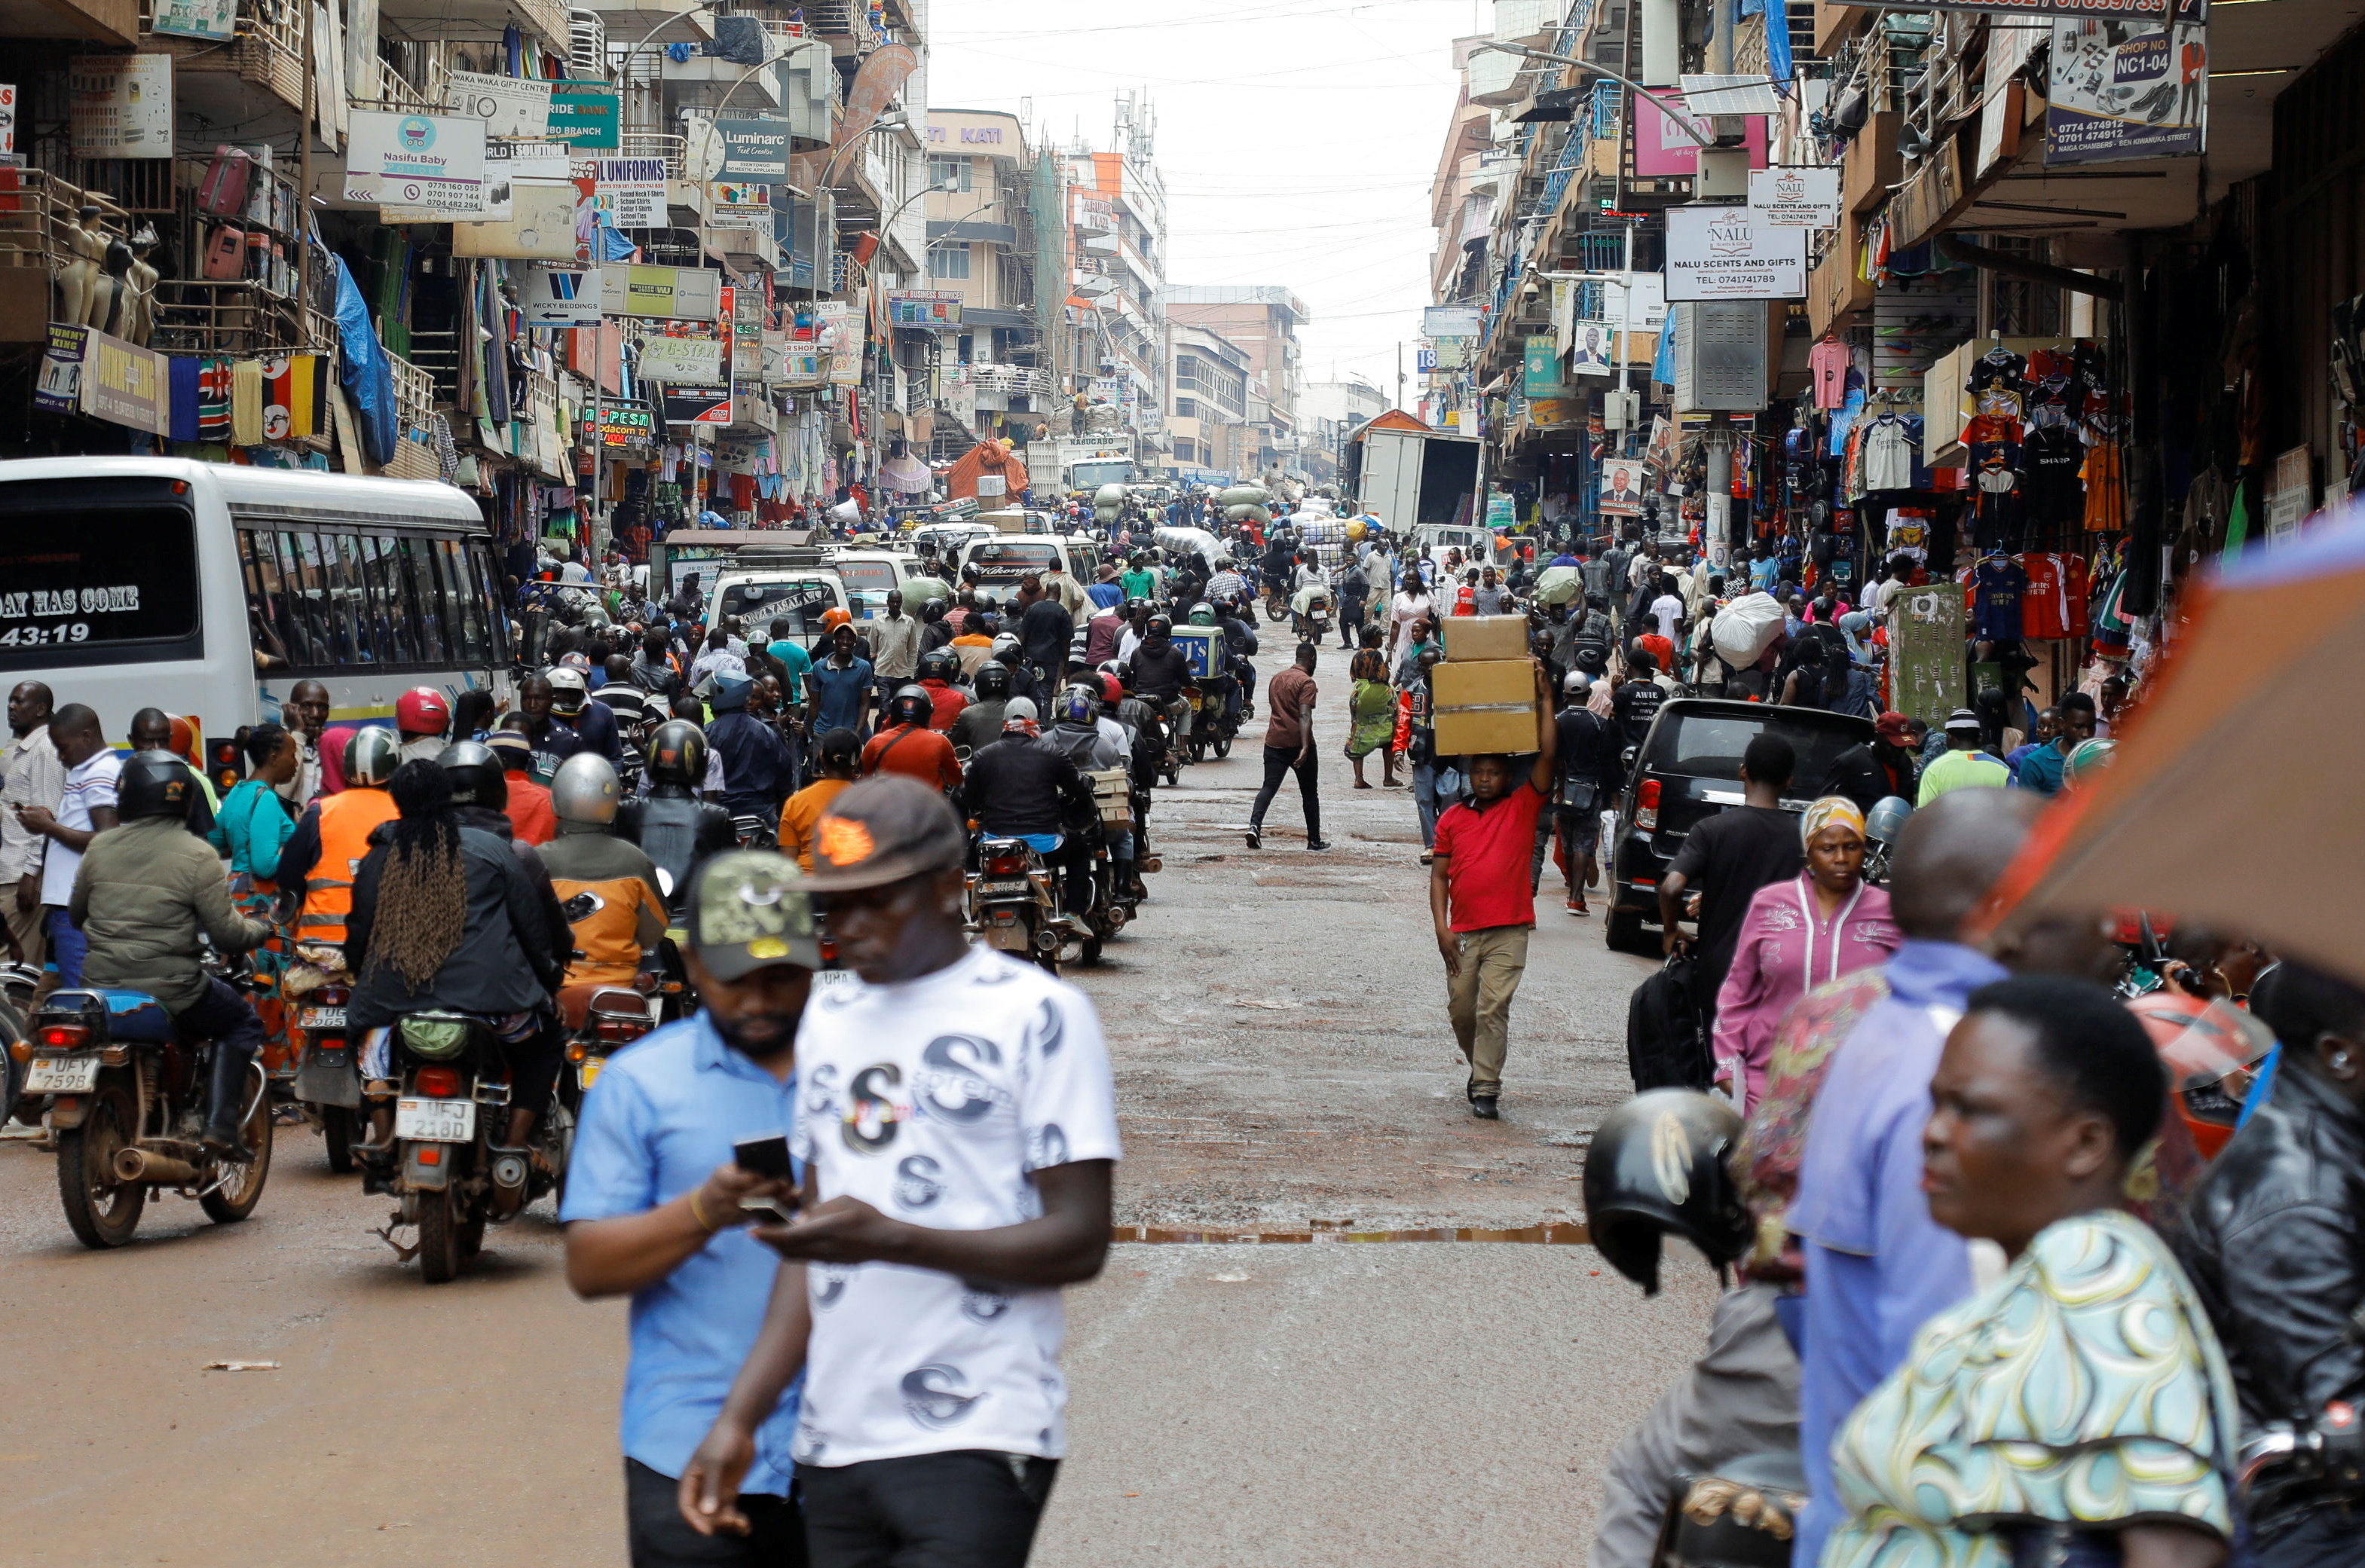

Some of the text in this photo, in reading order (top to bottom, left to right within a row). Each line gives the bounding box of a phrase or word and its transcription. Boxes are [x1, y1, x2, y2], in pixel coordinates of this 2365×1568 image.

[2118, 40, 2168, 56] SHOP NO.
[2116, 56, 2168, 75] NC1-04
[453, 74, 475, 83] WAKA
[477, 77, 498, 87] WAKA
[500, 81, 519, 89] GIFT
[521, 83, 549, 93] CENTRE
[549, 104, 608, 115] RIDE BANK
[564, 127, 601, 136] BRANCH
[2058, 120, 2124, 133] 0774 474912
[726, 130, 785, 145] Luminarc
[960, 127, 1003, 143] KATI
[2058, 130, 2123, 143] 0701 474912
[2058, 144, 2079, 152] NAIGA
[2080, 141, 2113, 151] CHAMBERS
[2119, 138, 2131, 146] BEN
[2132, 136, 2166, 146] KIWANUKA
[2167, 133, 2191, 142] STREET
[736, 146, 749, 154] Feel
[384, 152, 447, 166] Nasifu Baby
[387, 164, 443, 175] Parlour
[607, 160, 664, 182] UNIFORMS
[1775, 183, 1805, 192] NALU
[1707, 228, 1753, 241] NALU
[1718, 275, 1776, 283] 0741741789
[910, 290, 937, 299] BUSINESS
[938, 292, 963, 300] SERVICES
[49, 327, 86, 350] DUMMY KING
[668, 341, 715, 358] G-STAR
[1418, 351, 1436, 368] 18
[609, 411, 648, 426] PESA
[600, 424, 635, 435] odacom
[2039, 457, 2070, 465] SHARP
[1600, 501, 1624, 509] COUNCILLOR
[0, 585, 139, 618] AY HAS COME
[0, 623, 90, 646] 43:19
[55, 1059, 90, 1073] UFY
[44, 1075, 87, 1089] 759B
[427, 1102, 466, 1118] UFJ
[415, 1120, 464, 1139] 218D
